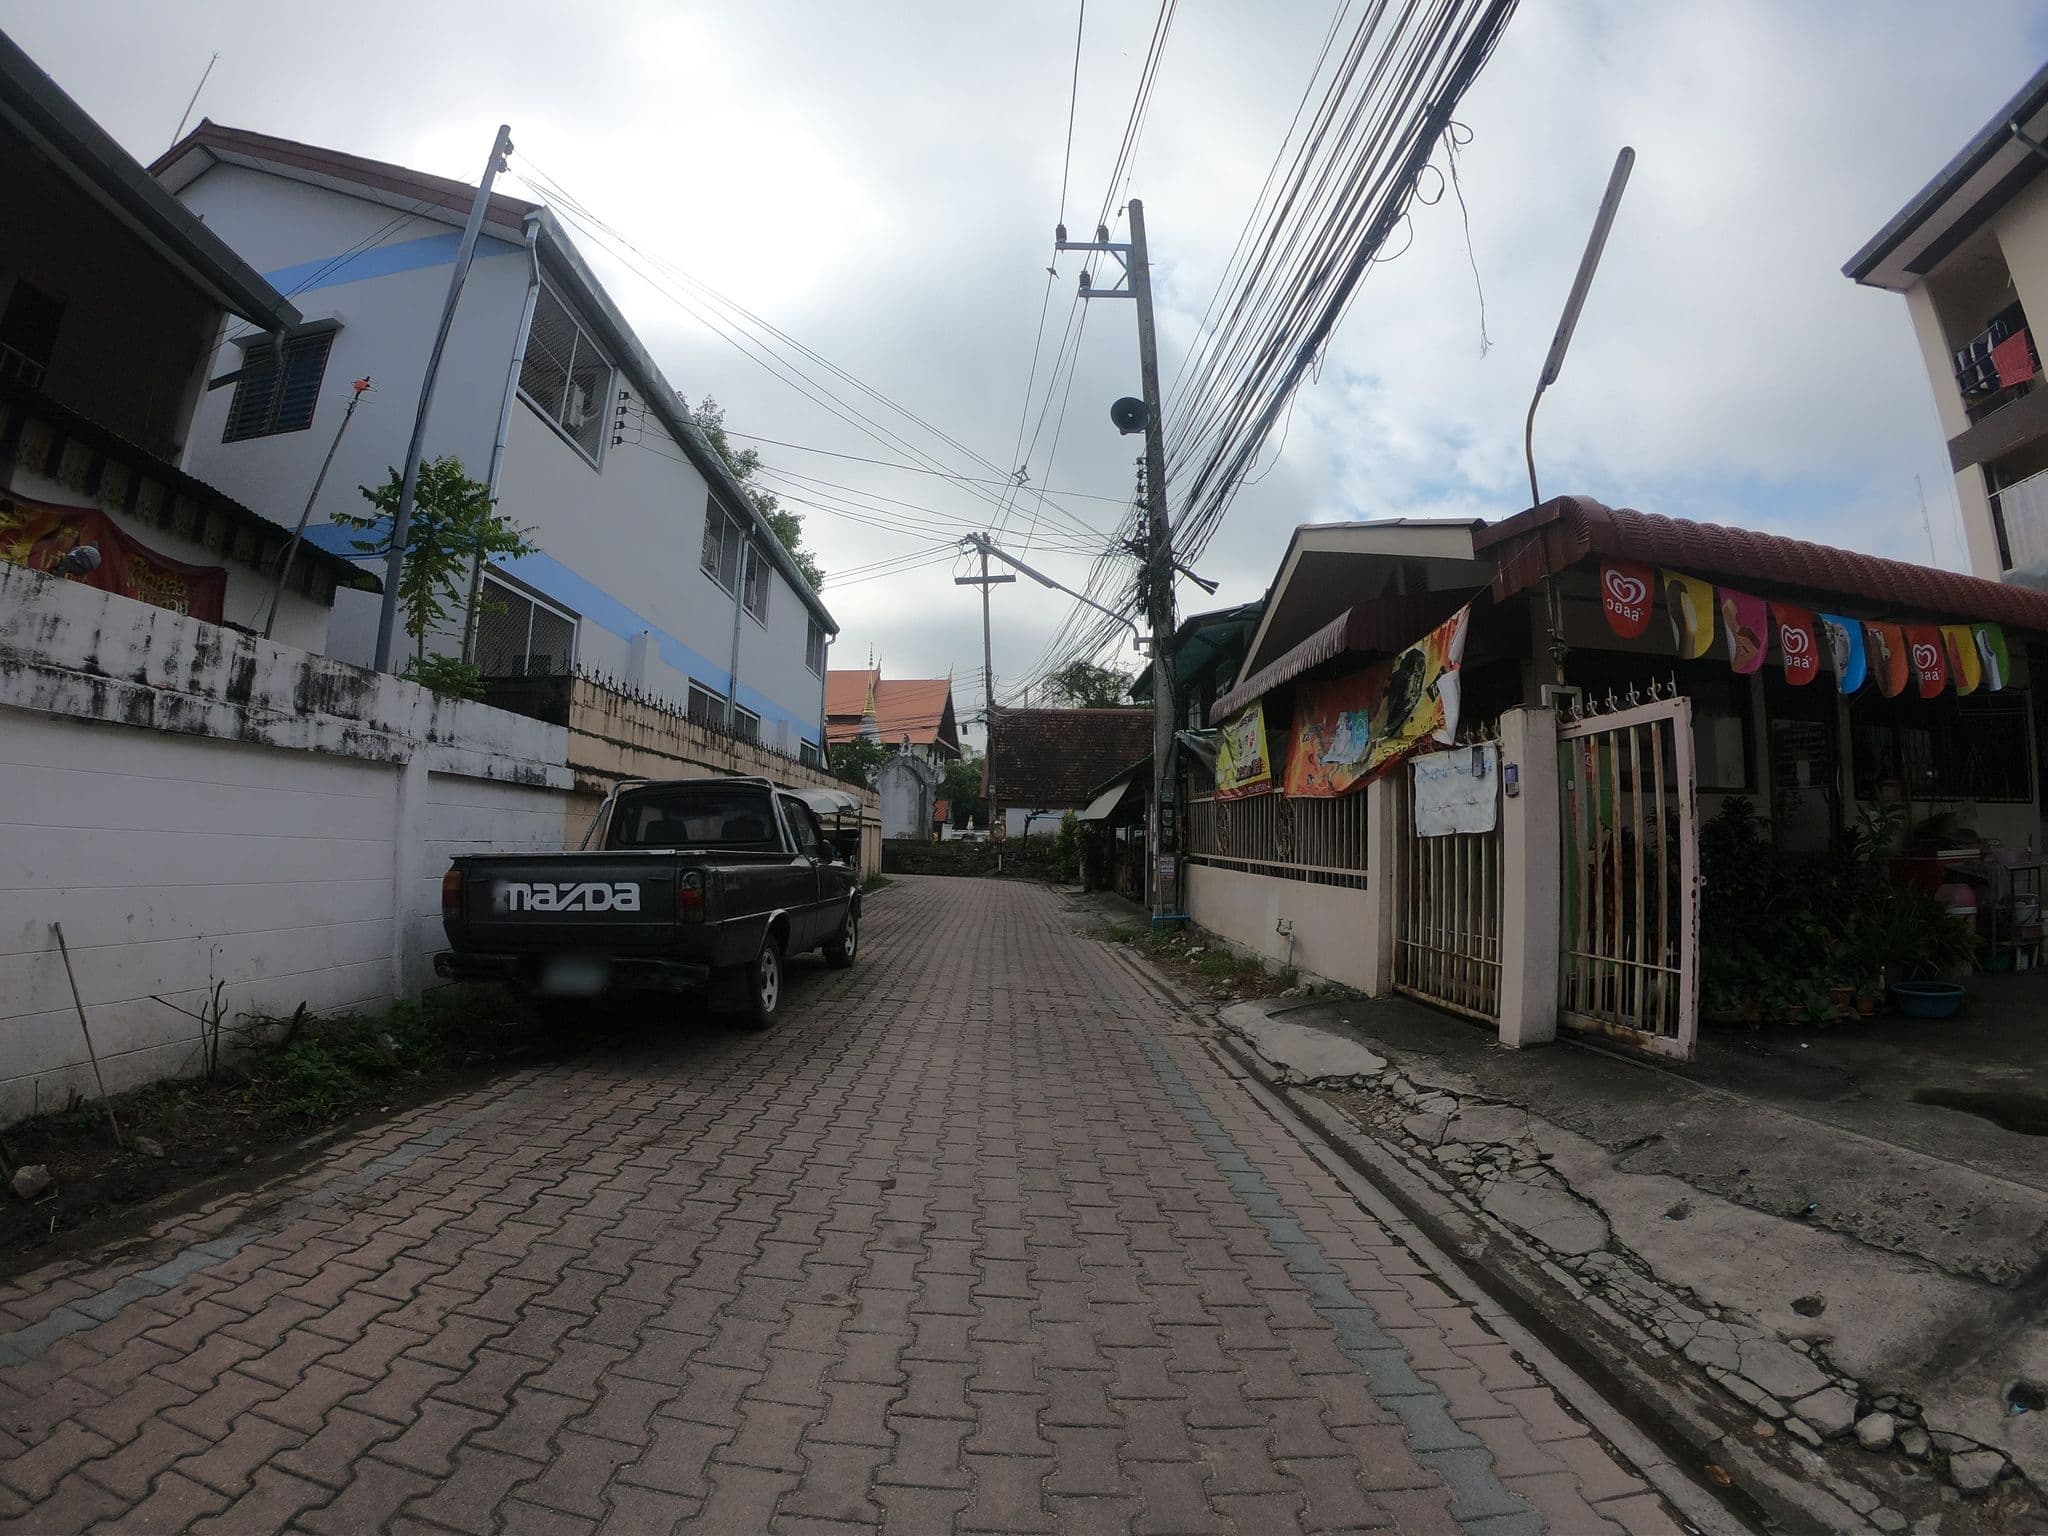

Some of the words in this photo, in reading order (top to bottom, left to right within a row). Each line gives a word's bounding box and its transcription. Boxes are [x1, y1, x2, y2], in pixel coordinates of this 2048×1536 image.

[1606, 598, 1641, 622] วอลล์
[1784, 655, 1810, 668] อลล์
[497, 882, 640, 911] mazda
